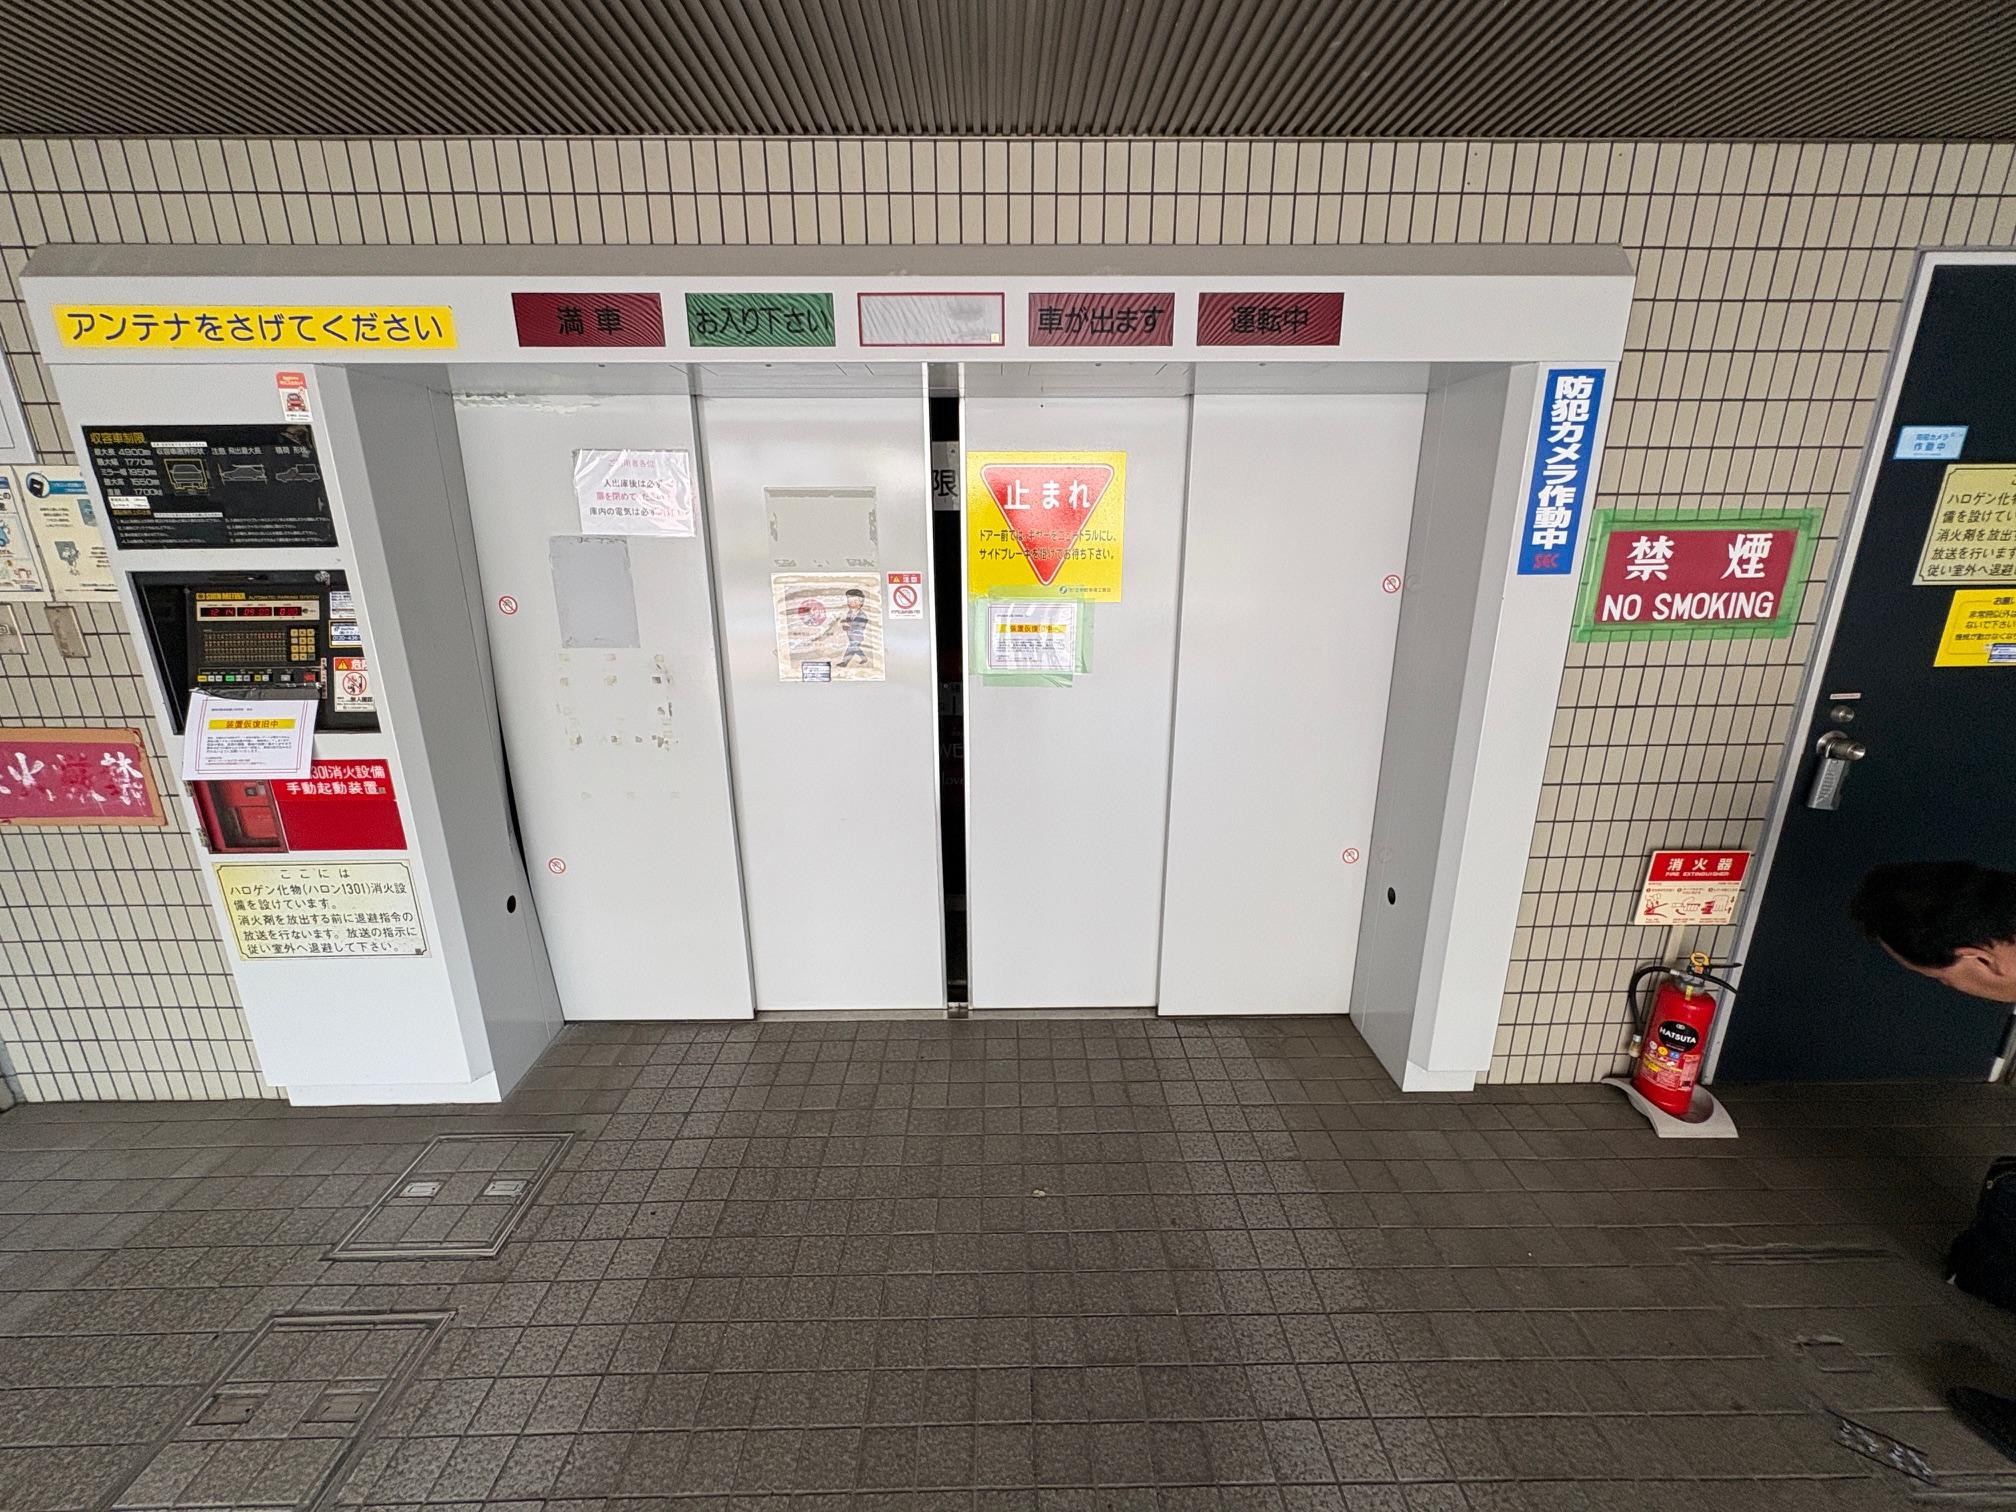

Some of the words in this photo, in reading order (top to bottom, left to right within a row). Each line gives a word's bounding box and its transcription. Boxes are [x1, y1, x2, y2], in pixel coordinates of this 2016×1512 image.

[67, 312, 444, 343] アンテナをさげてください
[696, 308, 830, 335] お入り下さい
[1038, 305, 1164, 335] 車が出ます
[1230, 306, 1309, 335] 運転中
[1531, 375, 1595, 550] 防犯カメラ作動中
[1004, 480, 1091, 510] 止まれ
[1602, 593, 1642, 622] NO
[1652, 592, 1775, 620] SMOKING
[311, 765, 386, 779] 301消火設備
[286, 781, 378, 795] 手動起動装置
[280, 868, 351, 880] ここには
[1667, 857, 1733, 871] 消火器
[233, 898, 337, 911] 備を設けています。
[237, 912, 414, 926] 消火剤を放出する前に退避指令の
[1658, 1026, 1697, 1045] HATSUTA
